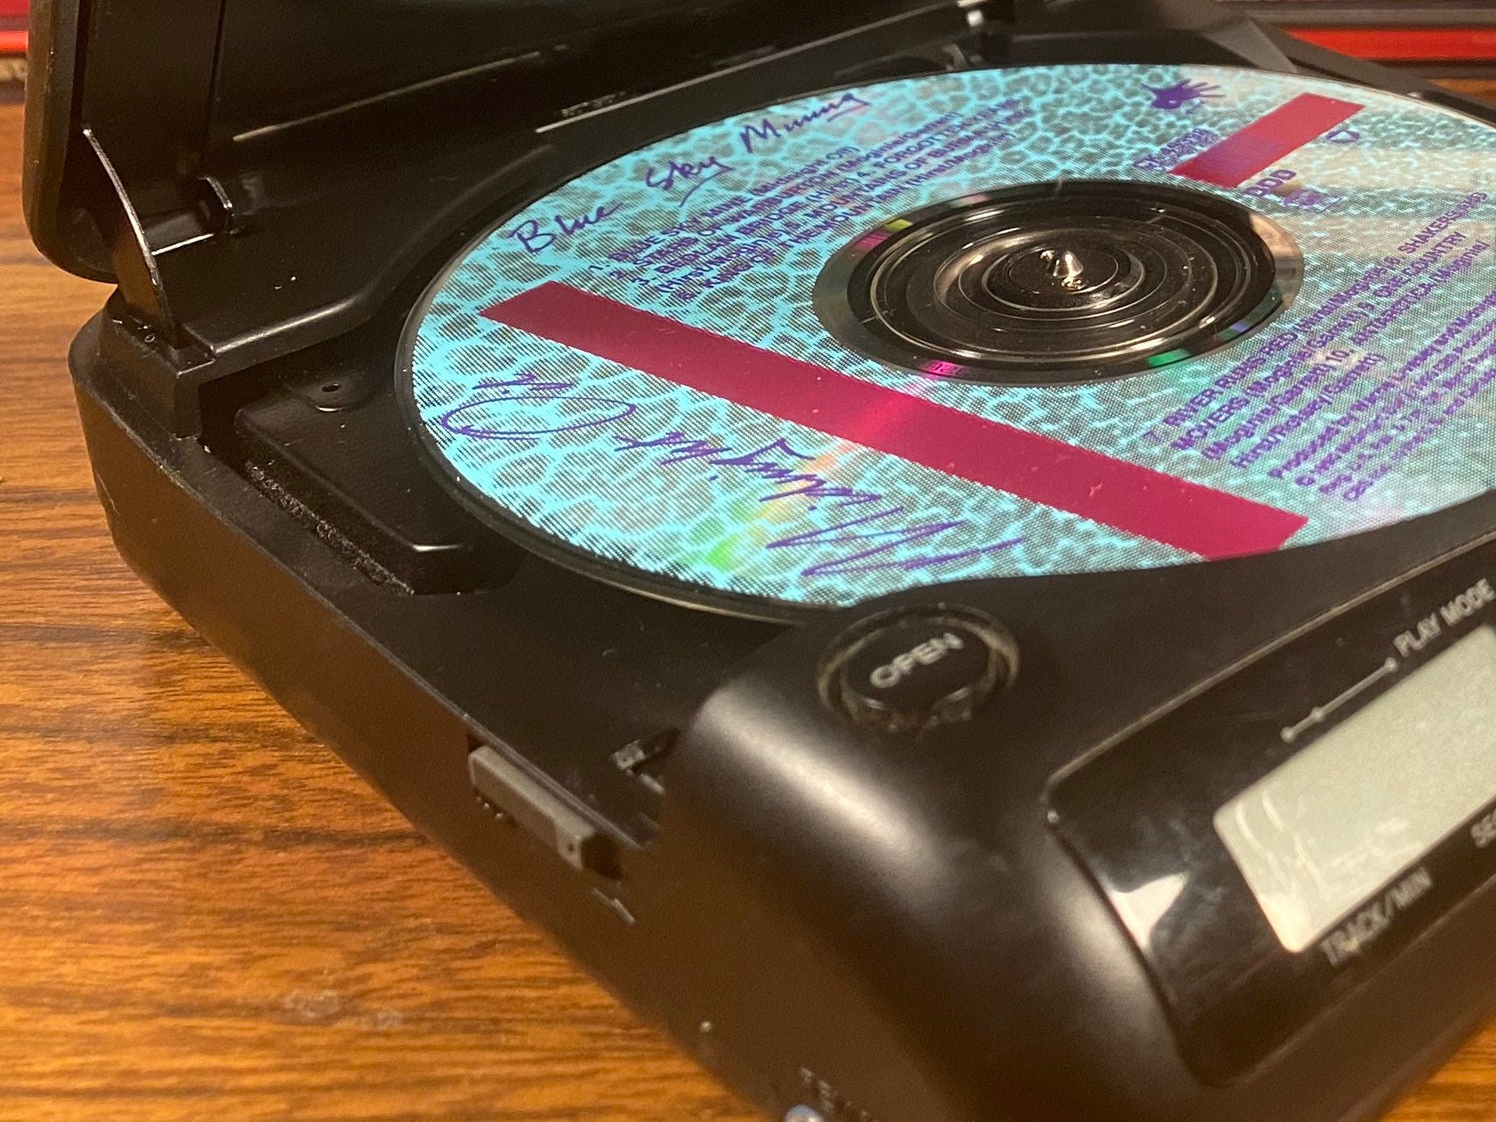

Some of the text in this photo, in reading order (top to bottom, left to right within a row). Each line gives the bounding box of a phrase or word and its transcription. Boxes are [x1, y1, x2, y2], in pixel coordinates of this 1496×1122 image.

[511, 90, 872, 256] Blue Sky Mining
[628, 236, 702, 268] STARS
[691, 221, 732, 237] OF
[719, 170, 843, 223] WARBURTON
[799, 169, 911, 219] MOUNTAINS
[898, 156, 936, 169] OF
[605, 235, 667, 262] BLUE
[657, 216, 709, 237] SKY
[697, 195, 756, 218] MINE
[650, 233, 742, 275] BEDLAM
[730, 200, 812, 235] BRIDGE
[696, 261, 759, 289] KING
[745, 247, 786, 264] OF
[807, 184, 913, 232] MOUNTAIN
[1159, 386, 1225, 427] RIVER
[1211, 354, 1269, 389] RUNS
[1255, 329, 1302, 357] RED
[1393, 208, 1466, 256] SHAKERS
[1165, 394, 1255, 452] MOVERS
[1368, 273, 1412, 300] ONE
[1396, 229, 1471, 278] COUNTRY
[1339, 278, 1444, 347] ANTARCTICA
[1393, 612, 1443, 659] PLAY
[1319, 866, 1434, 969] TRACK/MIN
